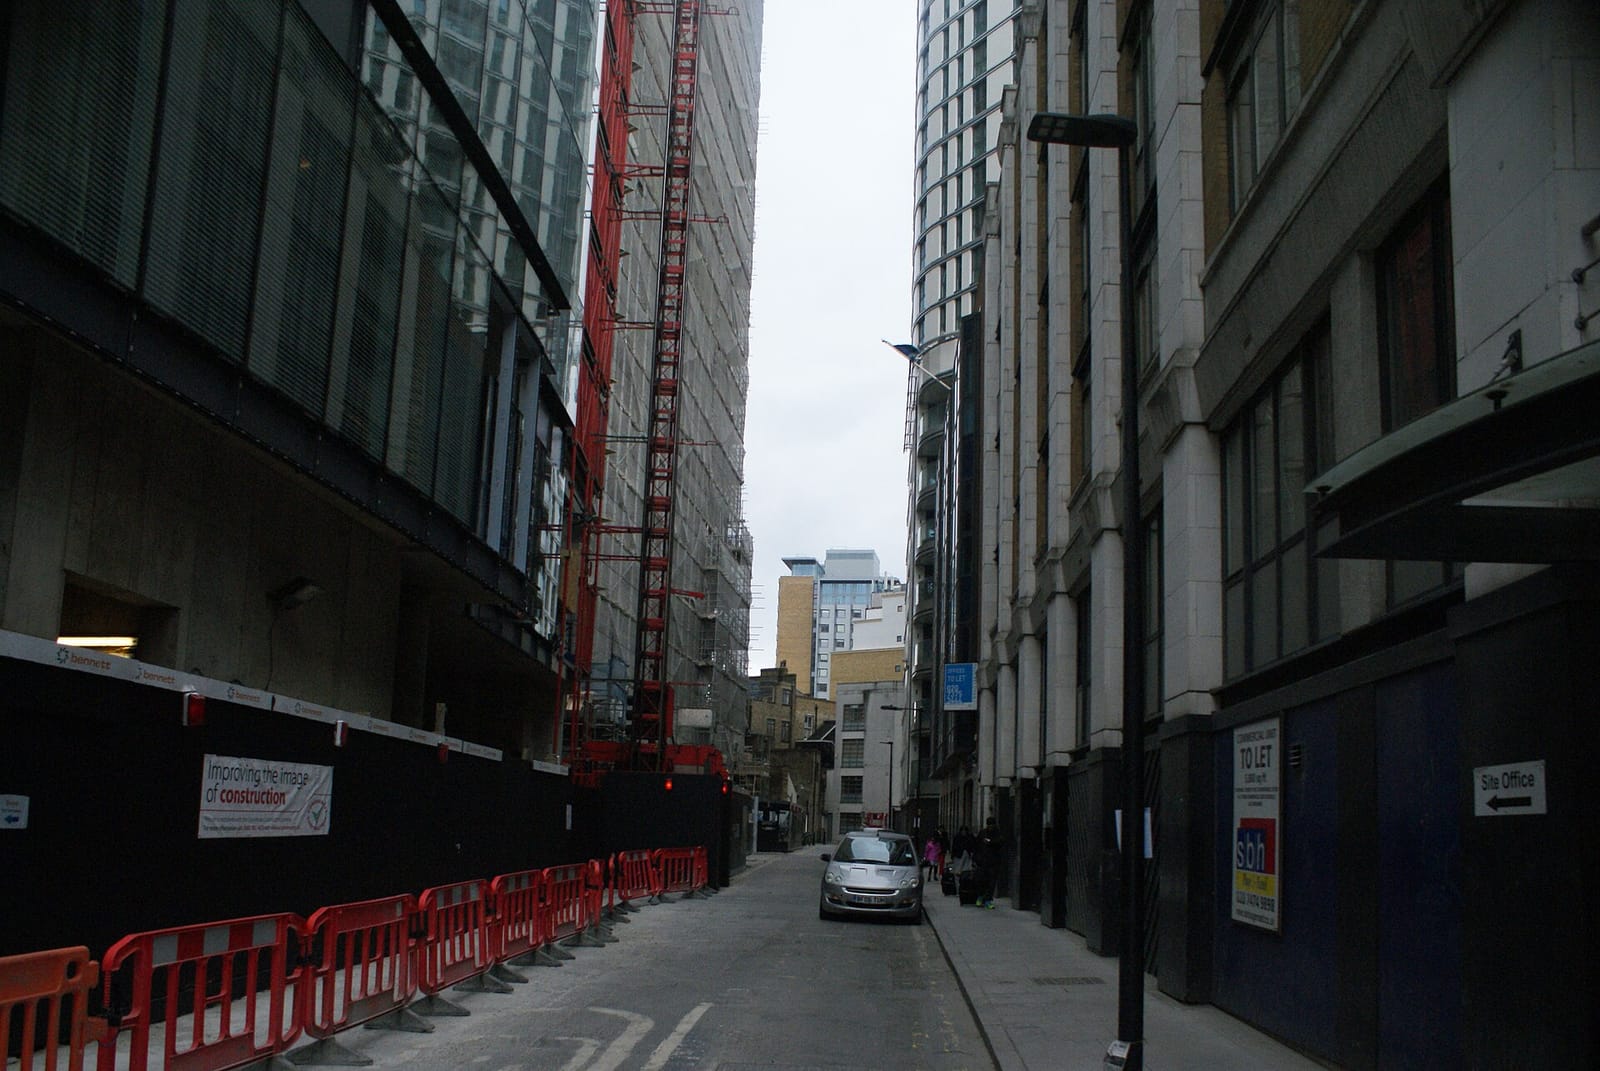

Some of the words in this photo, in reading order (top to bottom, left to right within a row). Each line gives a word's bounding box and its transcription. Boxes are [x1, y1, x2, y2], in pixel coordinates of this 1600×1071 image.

[70, 654, 112, 670] bennett
[143, 670, 177, 684] bennett
[1240, 747, 1253, 769] TO
[1255, 744, 1272, 768] LET
[207, 759, 261, 788] Improving
[263, 766, 278, 784] the
[280, 767, 309, 790] image
[1481, 774, 1499, 791] Site
[1501, 770, 1535, 789] Office
[206, 782, 219, 803] of
[220, 787, 287, 805] construction
[1237, 831, 1265, 871] sbh
